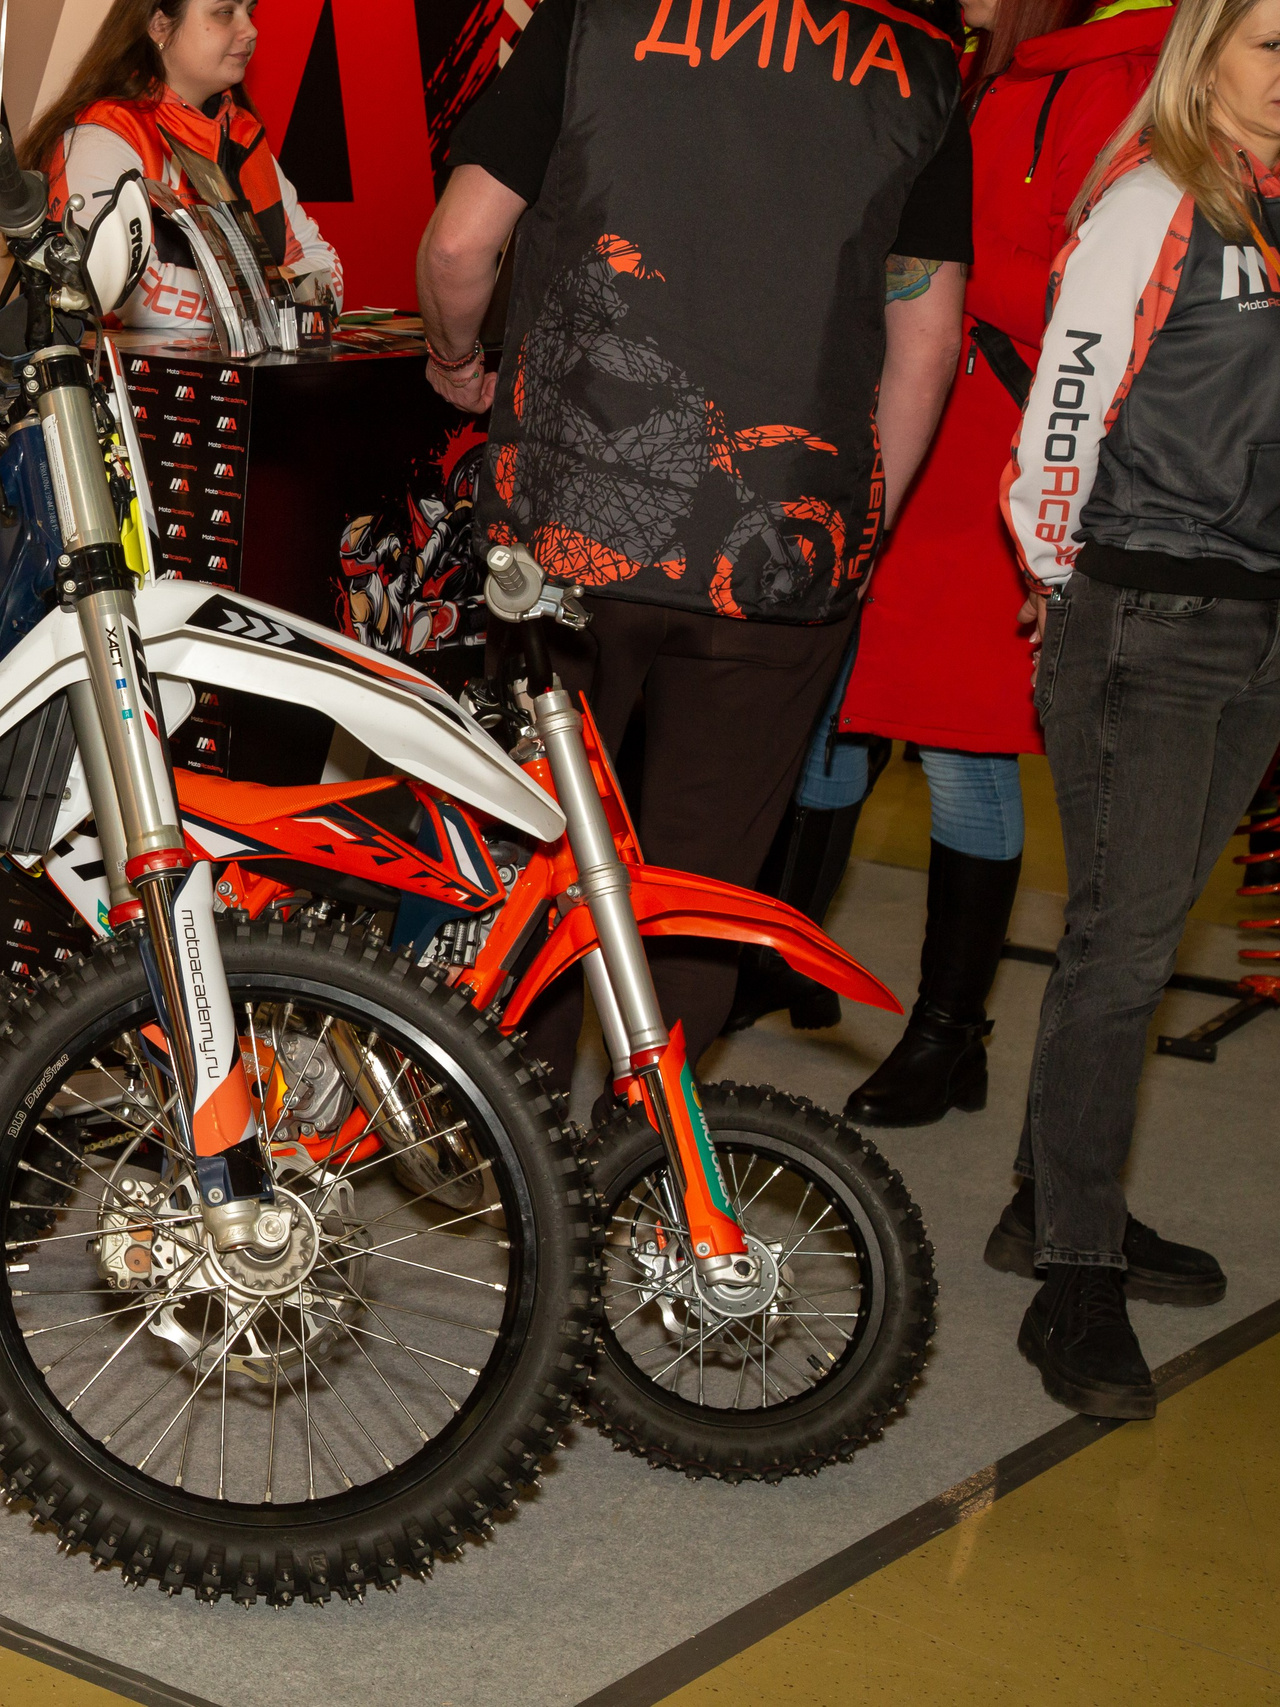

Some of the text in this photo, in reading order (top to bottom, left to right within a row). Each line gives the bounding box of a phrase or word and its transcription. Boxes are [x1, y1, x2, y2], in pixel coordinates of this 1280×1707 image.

[634, 0, 911, 98] ДИМА
[162, 552, 192, 564] toAcademy
[105, 626, 123, 668] XACT
[181, 909, 220, 1079] motoacademy.ru
